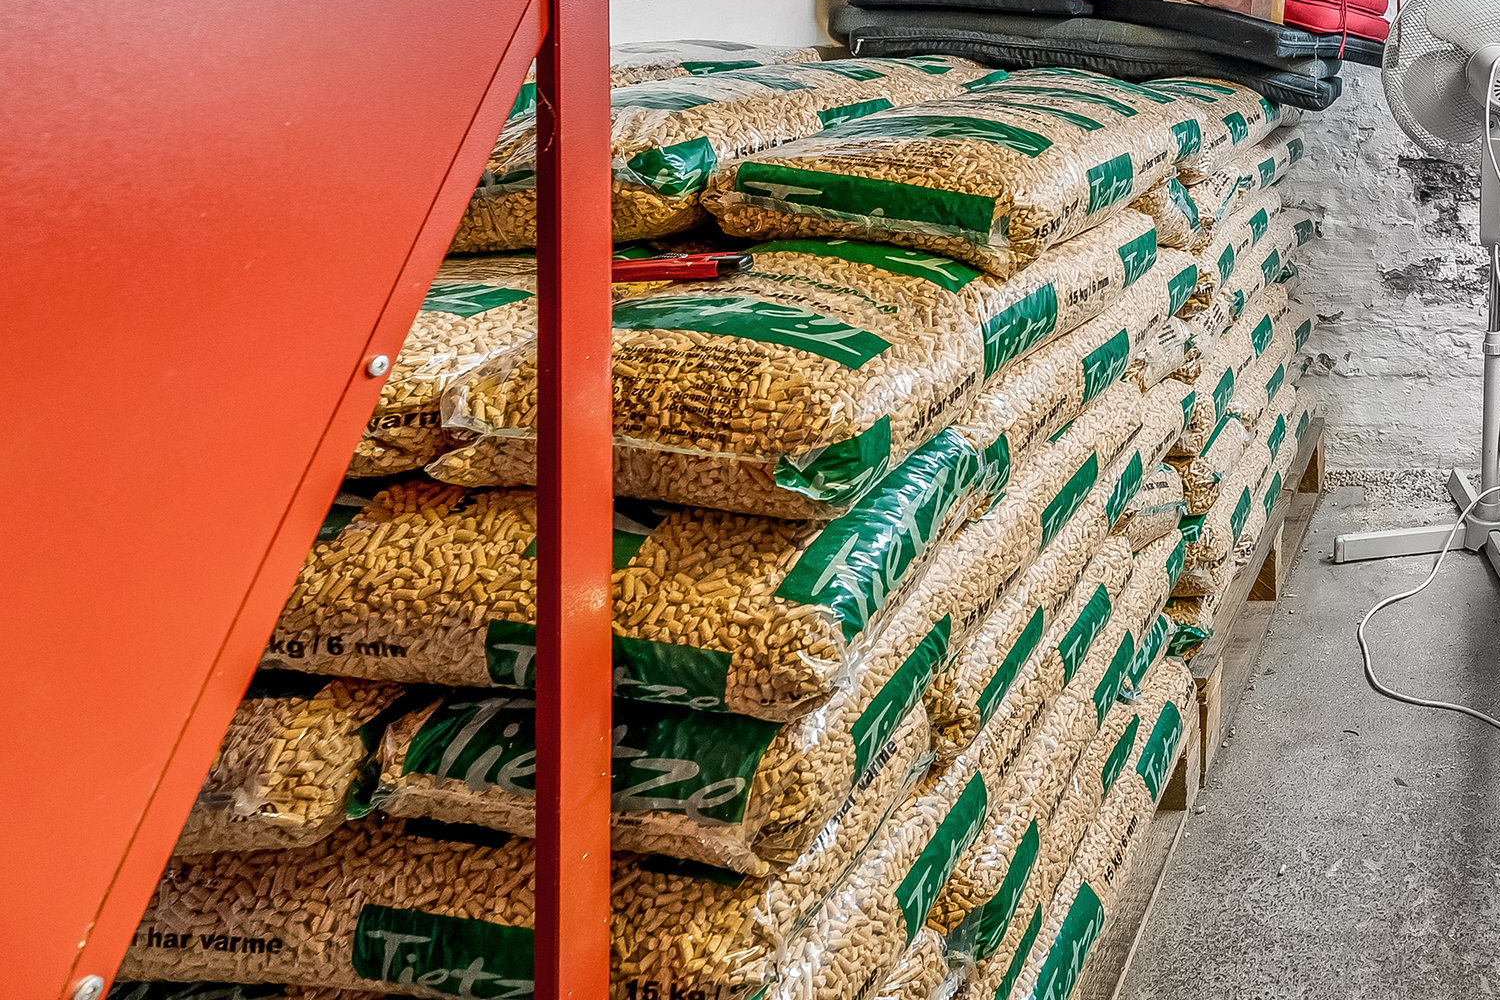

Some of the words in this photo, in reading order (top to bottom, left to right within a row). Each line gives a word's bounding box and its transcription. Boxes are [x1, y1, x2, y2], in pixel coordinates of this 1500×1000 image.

[269, 636, 305, 659] kg
[326, 636, 345, 657] 6
[857, 738, 898, 791] varme
[1102, 866, 1115, 887] 15
[1112, 854, 1124, 874] kg
[1127, 815, 1139, 840] mm
[147, 926, 191, 950] har
[199, 932, 284, 955] varme
